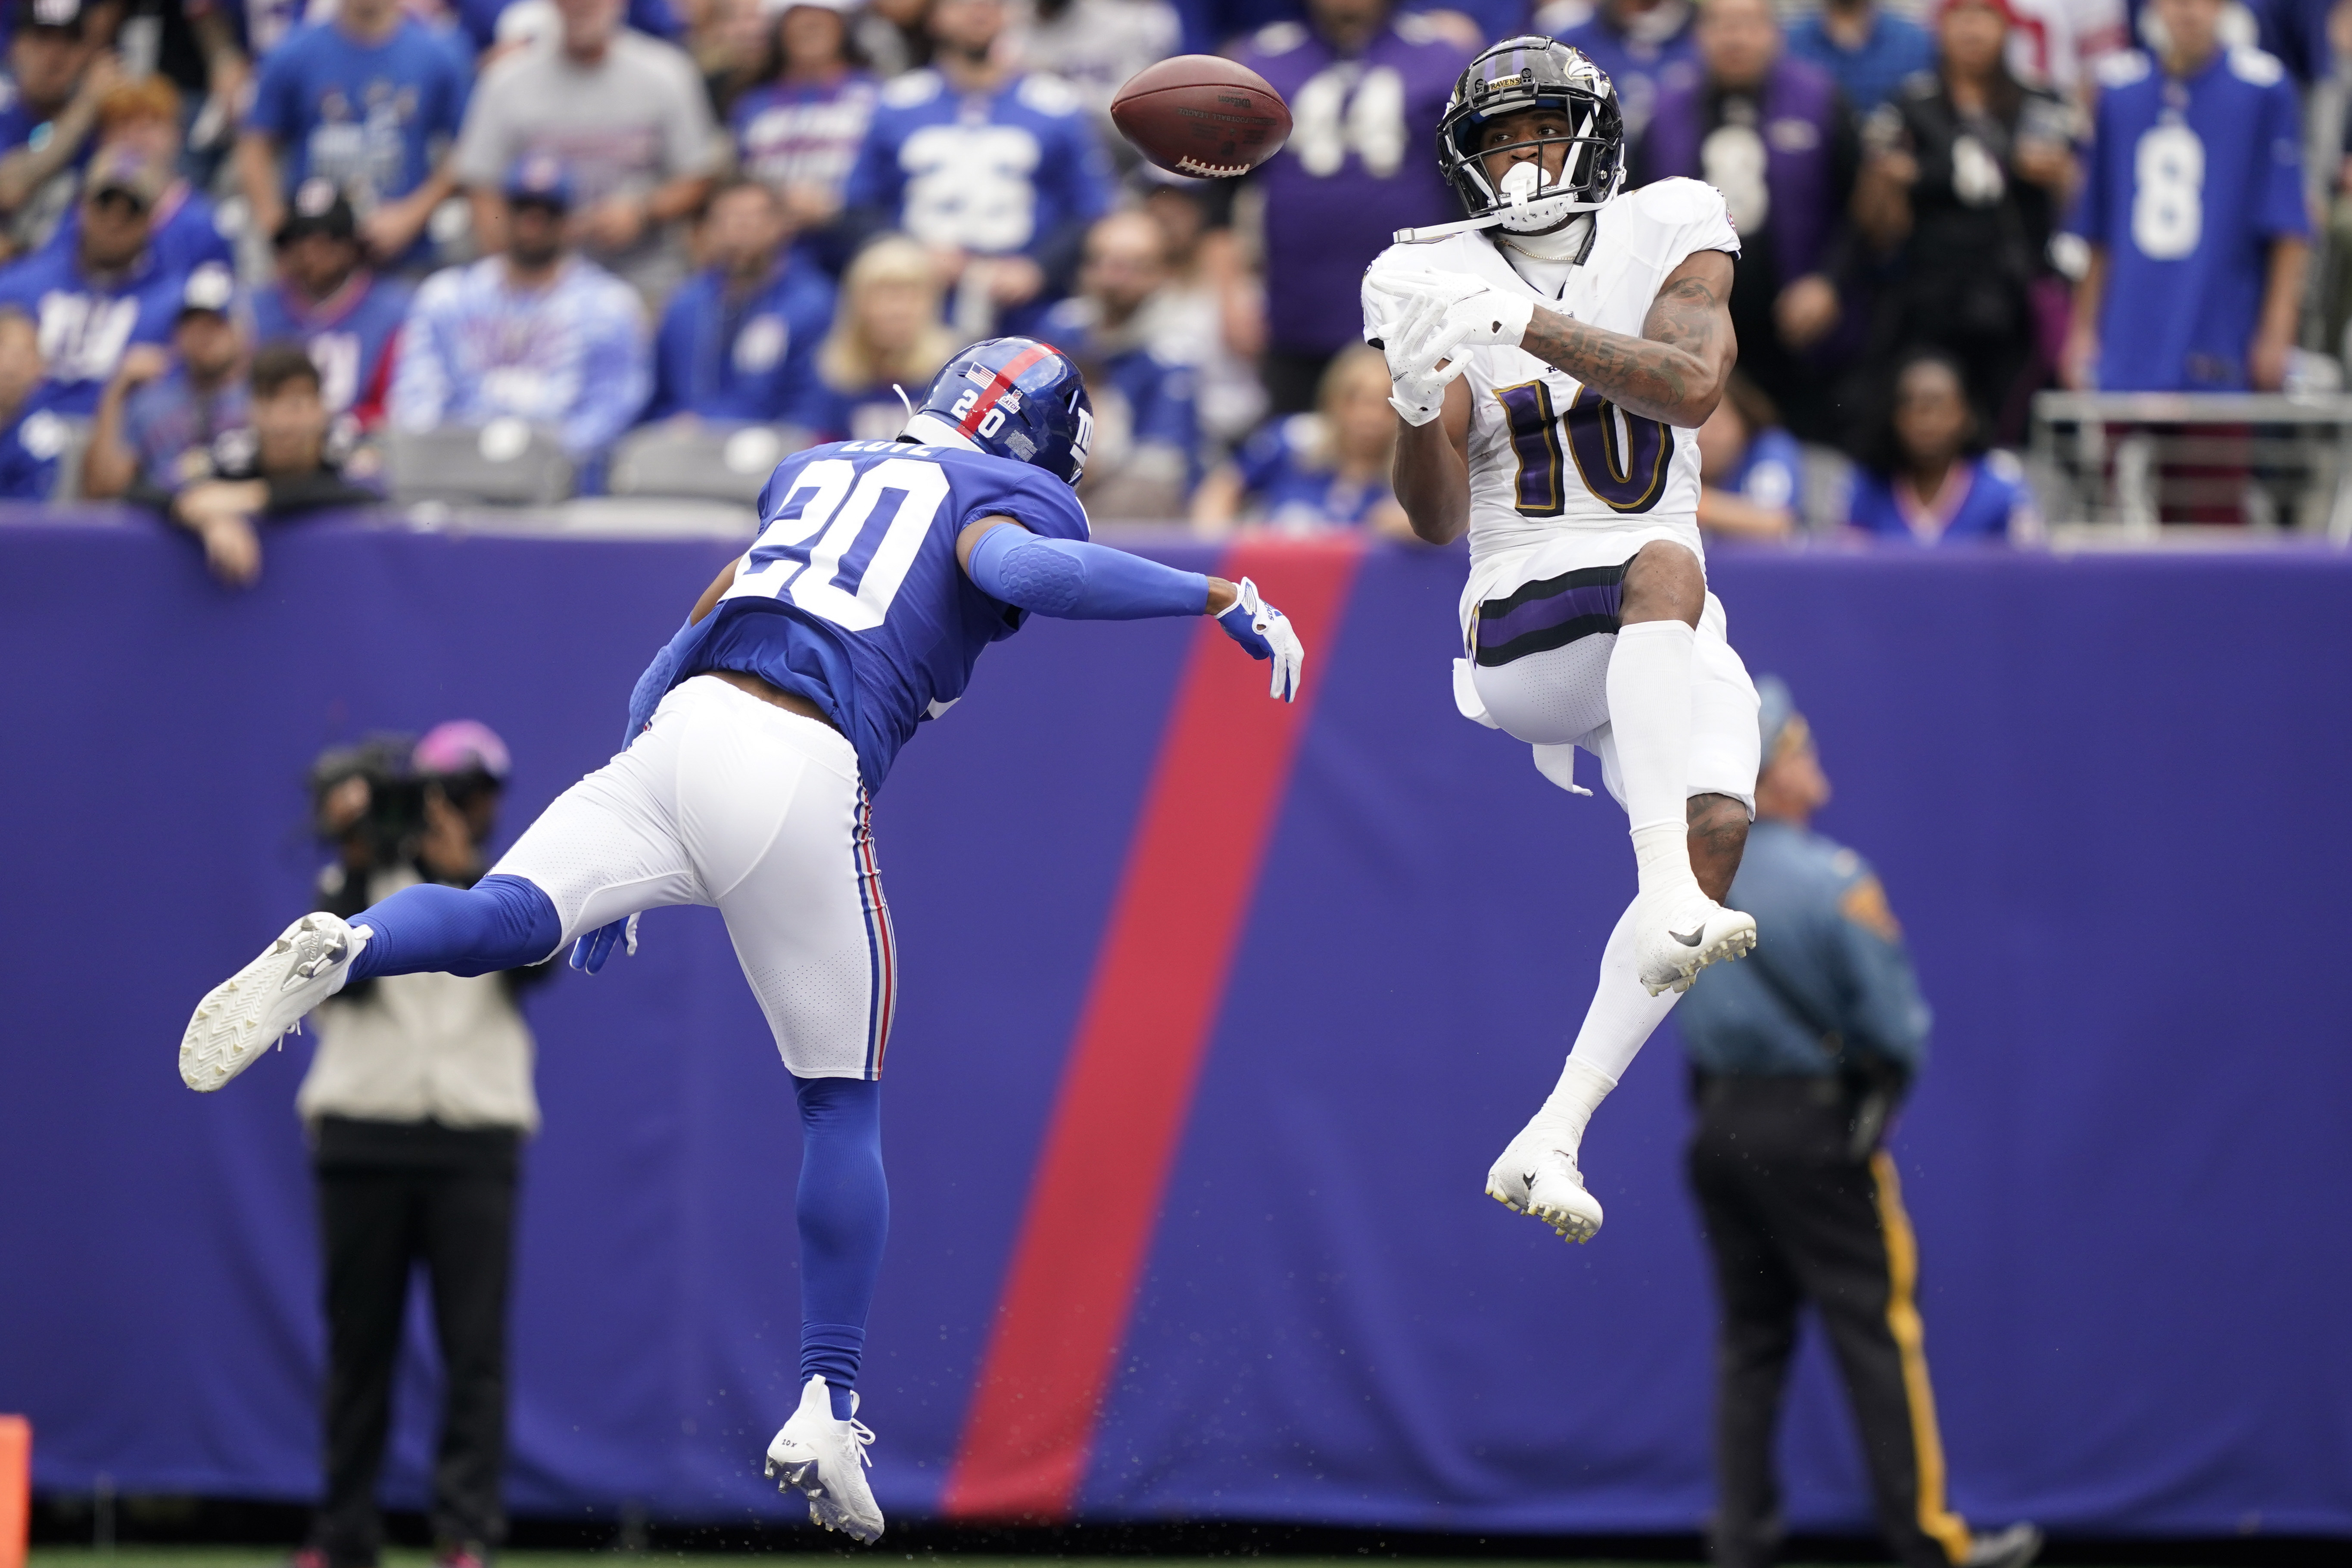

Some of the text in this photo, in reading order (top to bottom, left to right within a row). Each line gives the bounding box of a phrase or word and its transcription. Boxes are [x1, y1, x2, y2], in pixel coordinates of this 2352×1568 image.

[1490, 78, 1521, 90] RAVENS
[1218, 95, 1252, 108] Wilson
[1177, 108, 1208, 118] LEAGUE
[1212, 113, 1249, 123] FOOTBALL
[2132, 127, 2205, 259] 8
[1001, 397, 1019, 411] CATCH
[1492, 380, 1675, 517] 10
[717, 458, 950, 632] 20
